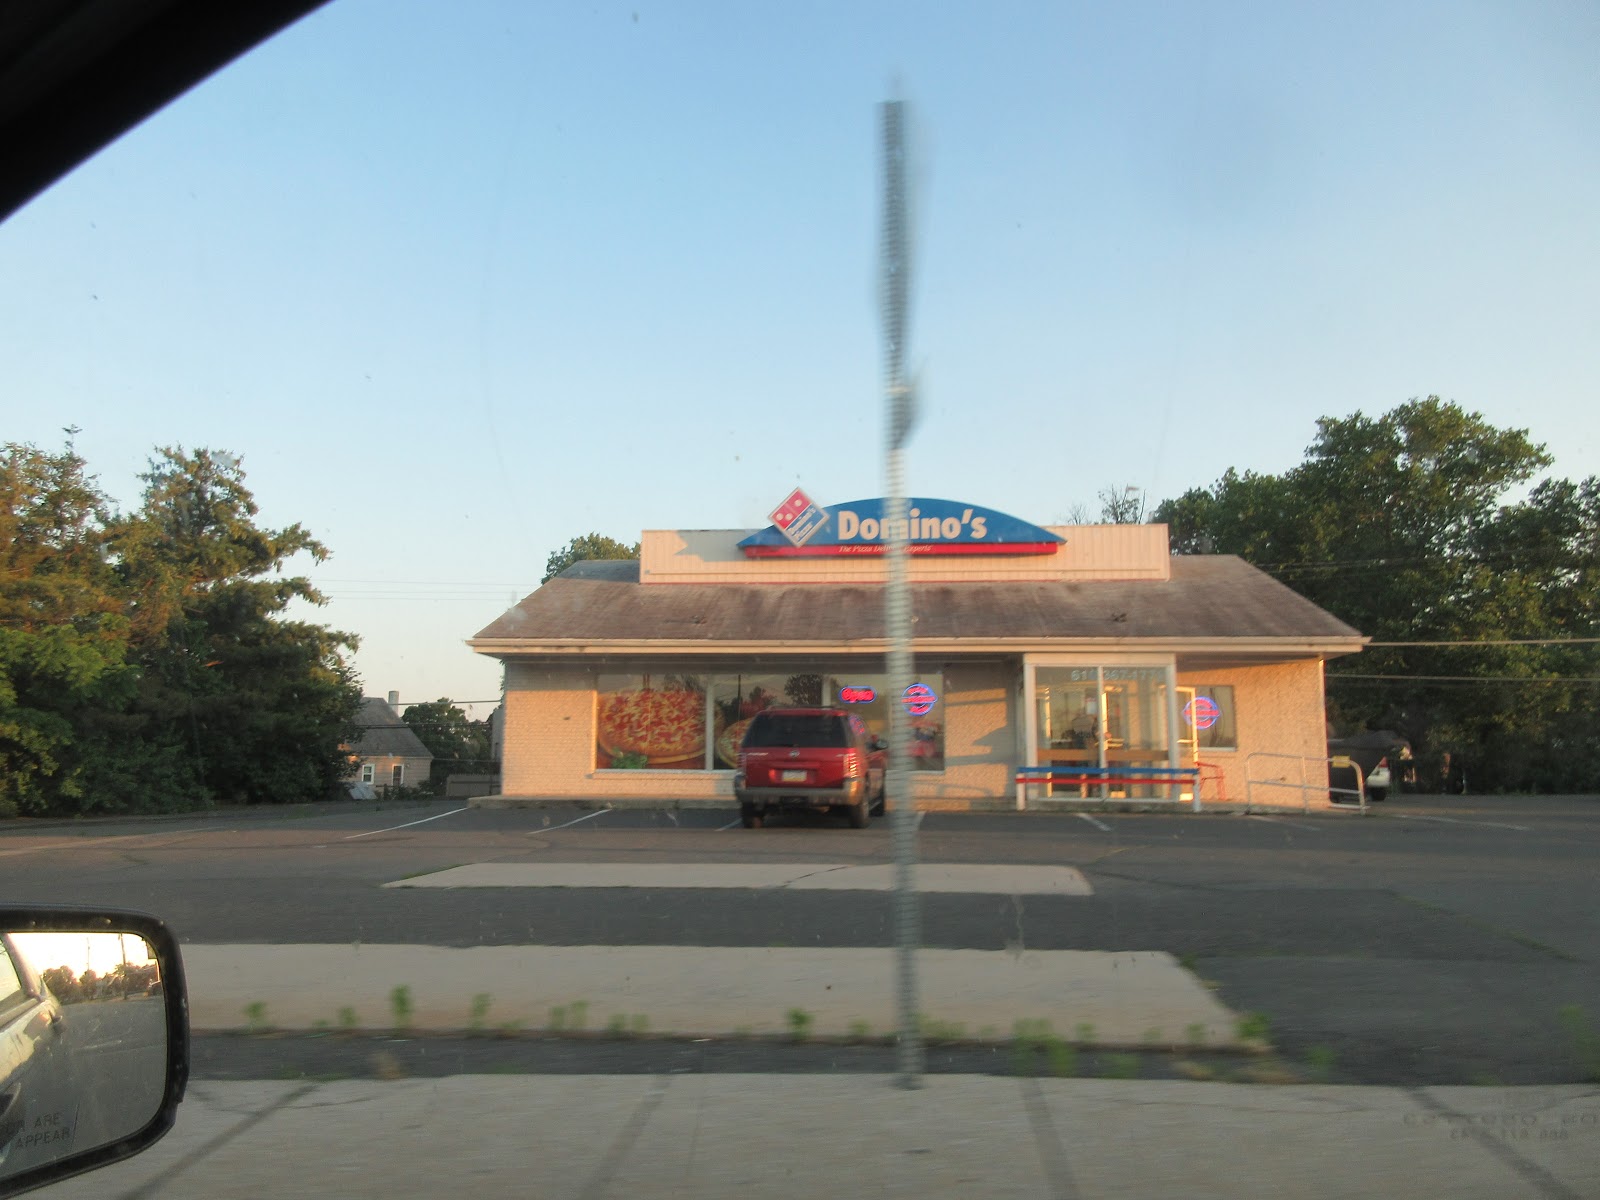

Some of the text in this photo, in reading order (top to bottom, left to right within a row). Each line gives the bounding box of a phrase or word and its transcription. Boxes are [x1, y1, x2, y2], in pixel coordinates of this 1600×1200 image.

[838, 507, 988, 541] Domino's
[34, 1112, 61, 1128] ARE
[15, 1127, 70, 1149] APPEAR
